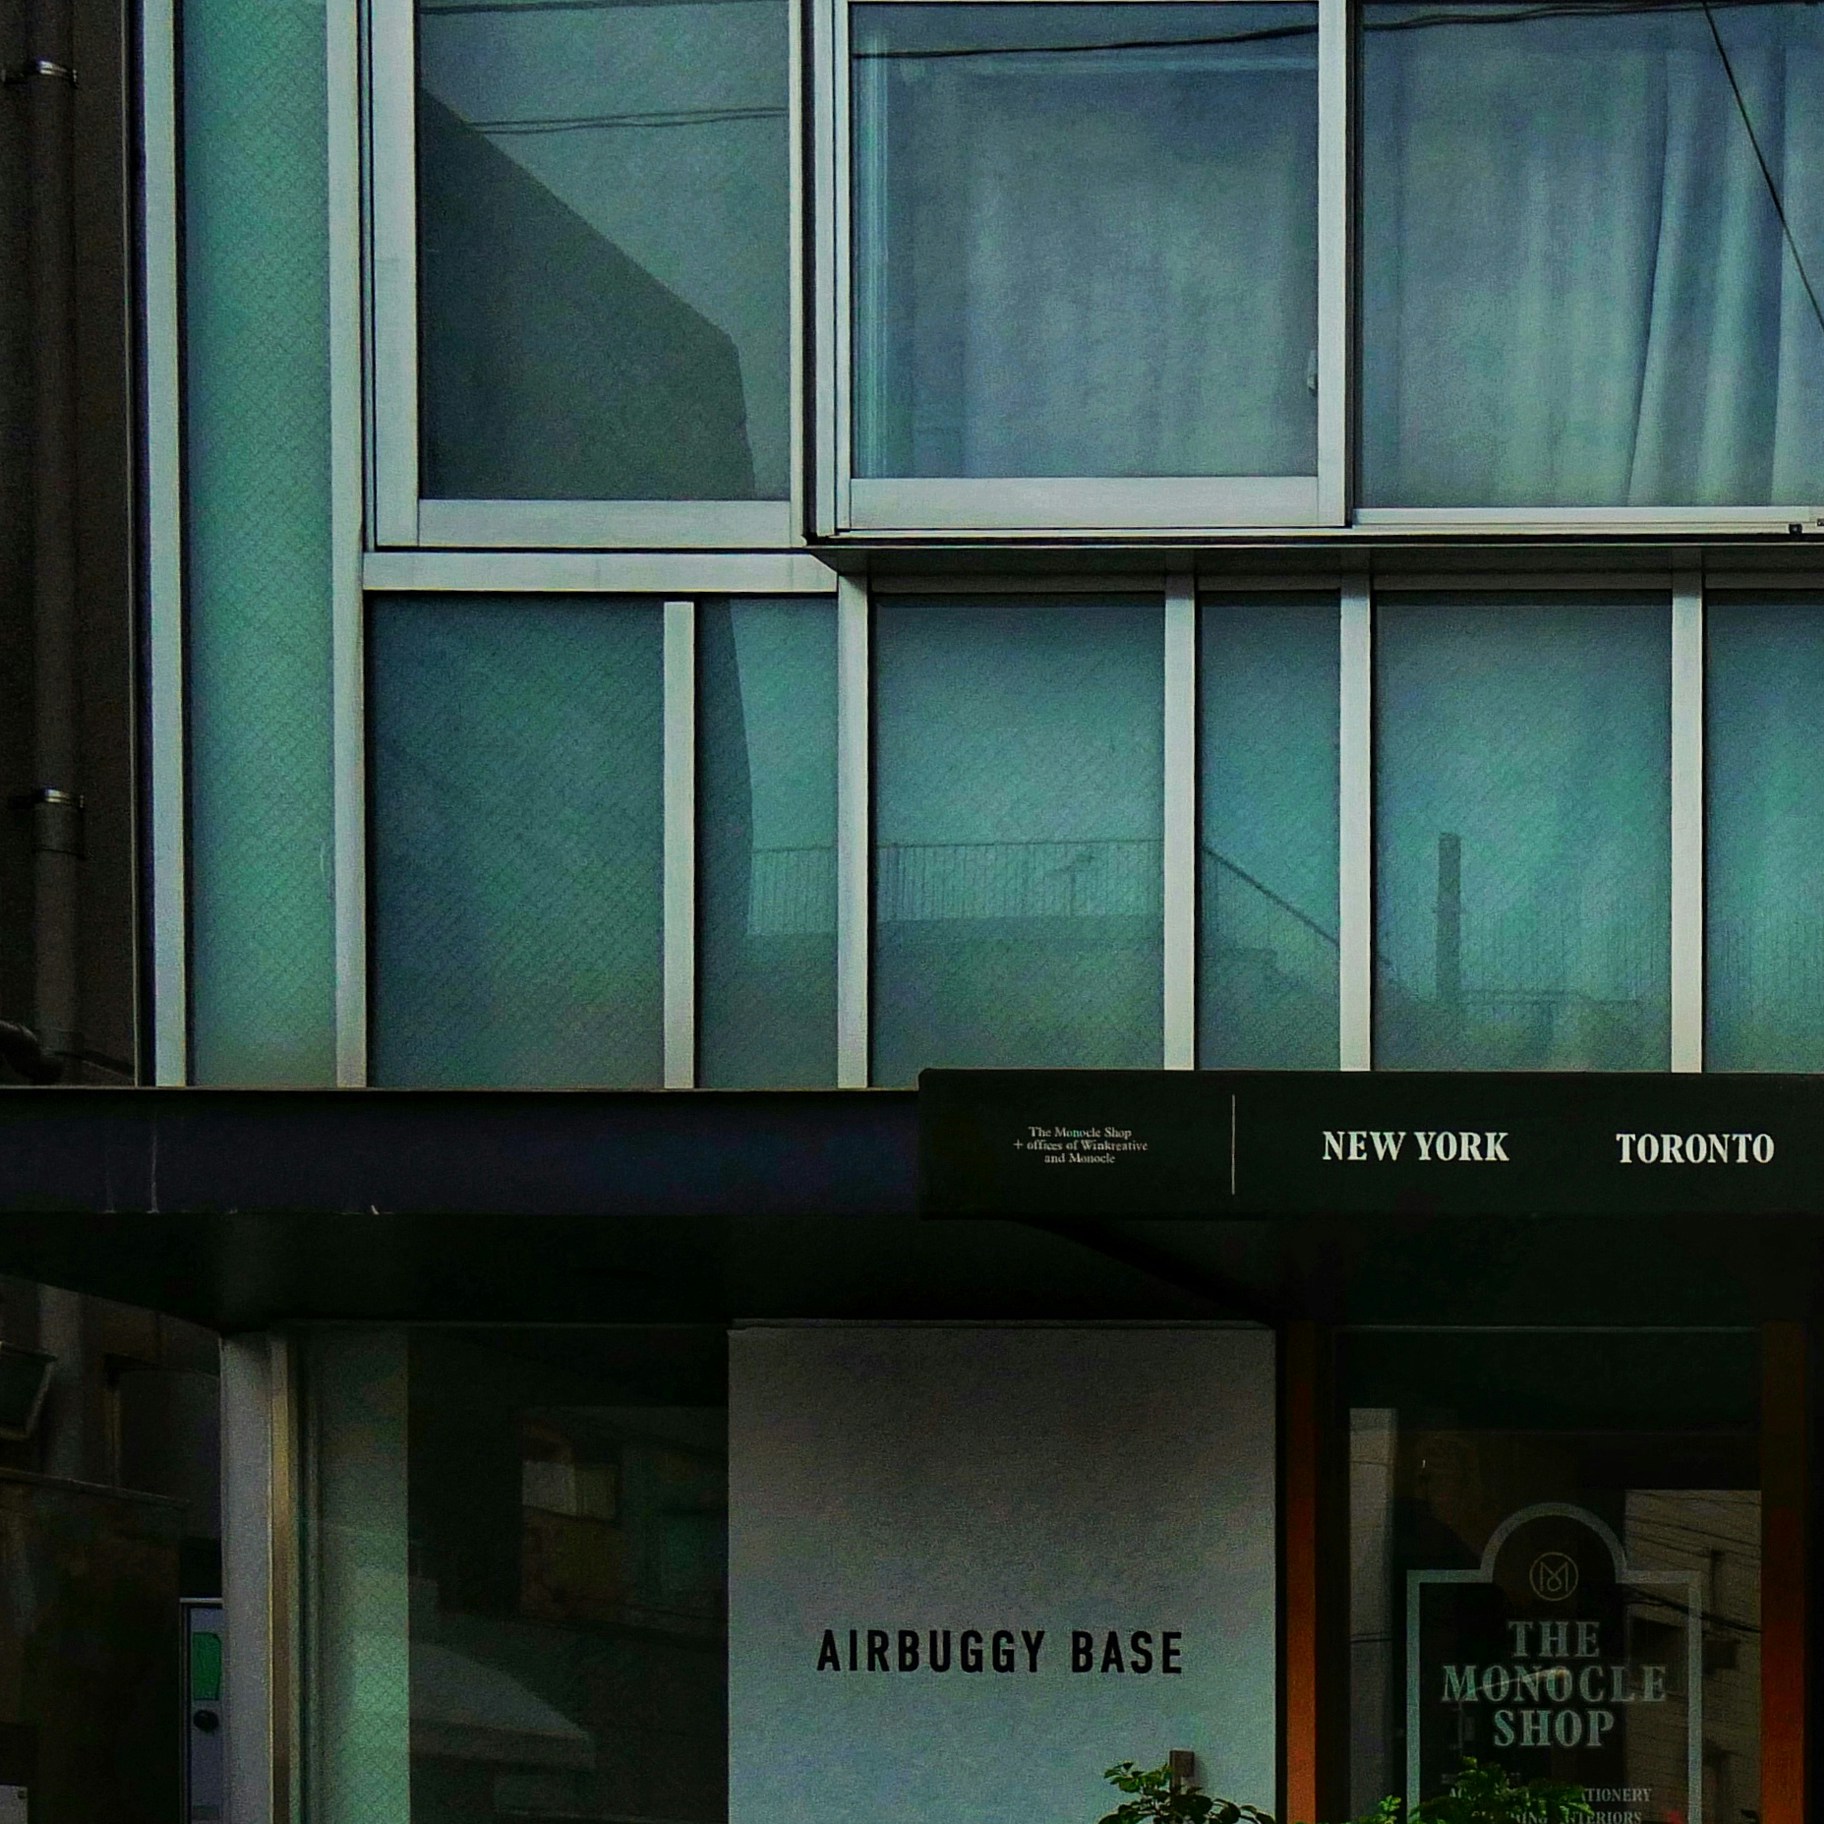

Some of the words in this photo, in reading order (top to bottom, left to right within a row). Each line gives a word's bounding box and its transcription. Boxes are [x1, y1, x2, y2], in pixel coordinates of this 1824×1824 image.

[1026, 1139, 1063, 1151] offices
[1066, 1139, 1079, 1151] of
[1081, 1139, 1149, 1151] Winkreative
[1028, 1126, 1051, 1138] The
[1054, 1126, 1101, 1138] Monocle
[1104, 1126, 1132, 1140] Shop
[1322, 1130, 1405, 1162] NEW
[1413, 1131, 1510, 1162] YORK
[1615, 1132, 1775, 1164] TORONTO
[1044, 1152, 1066, 1164] and
[1068, 1152, 1116, 1164] Monocle
[817, 1629, 1045, 1673] AIRBUGGY
[1072, 1631, 1183, 1675] BASE
[1507, 1620, 1600, 1658] THE
[1440, 1664, 1667, 1703] MONOCLE
[1493, 1708, 1615, 1748] SHOP
